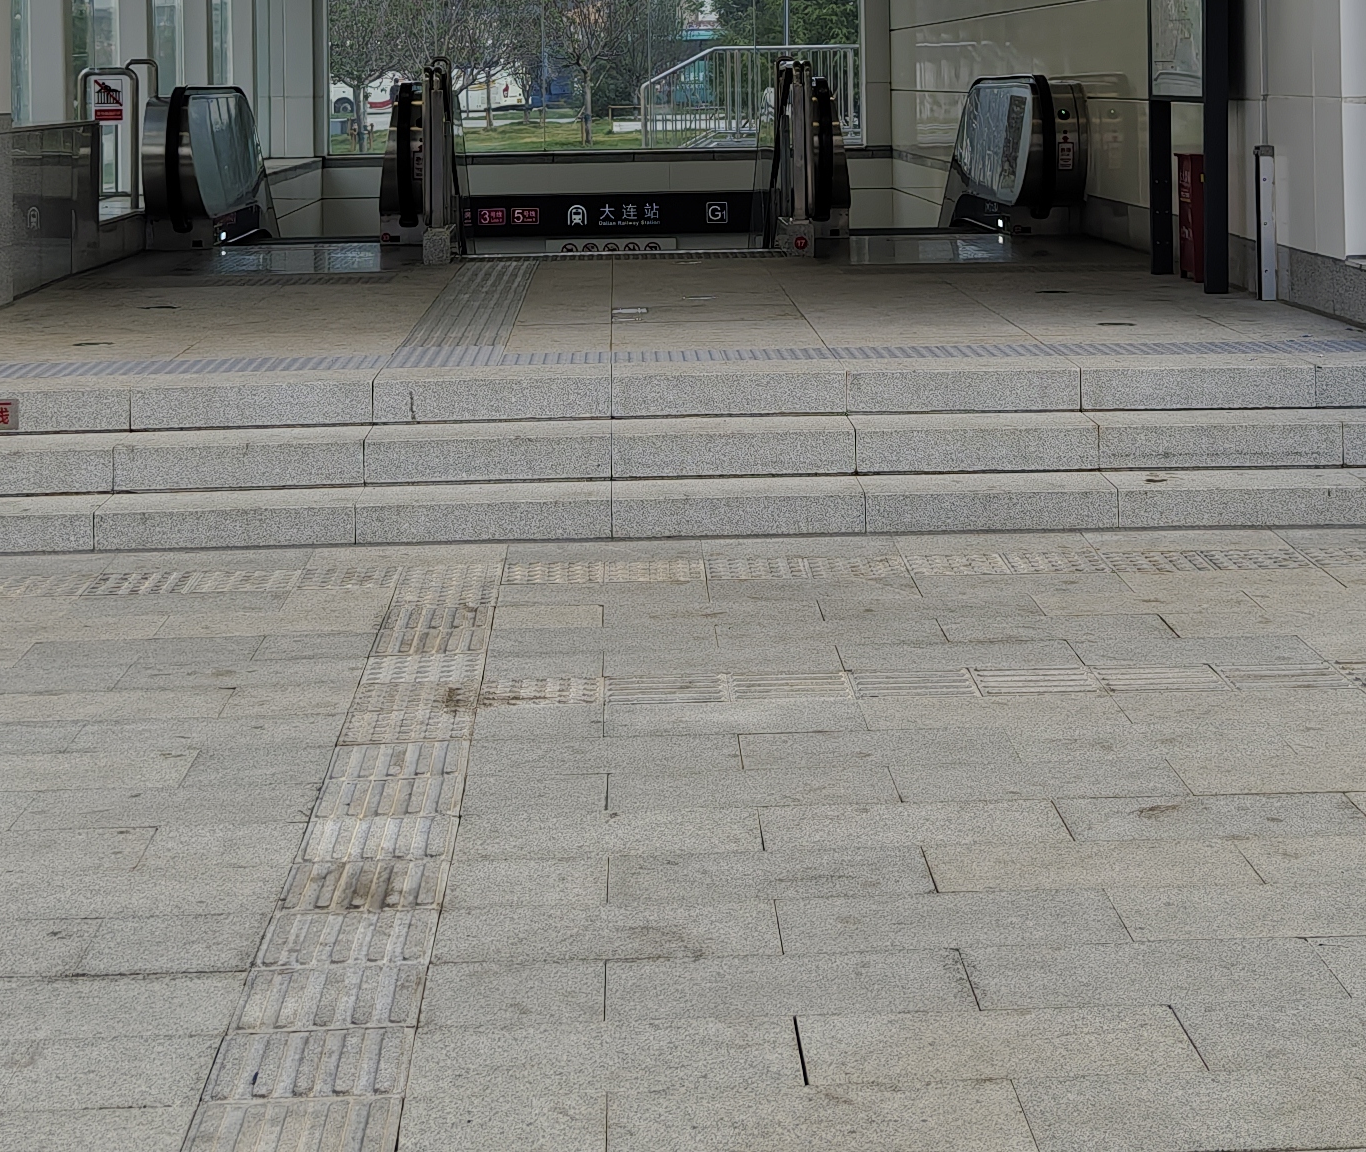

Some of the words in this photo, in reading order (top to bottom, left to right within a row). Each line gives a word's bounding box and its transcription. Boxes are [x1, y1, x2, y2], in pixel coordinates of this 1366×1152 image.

[599, 203, 660, 220] 大连站
[708, 206, 726, 221] G1
